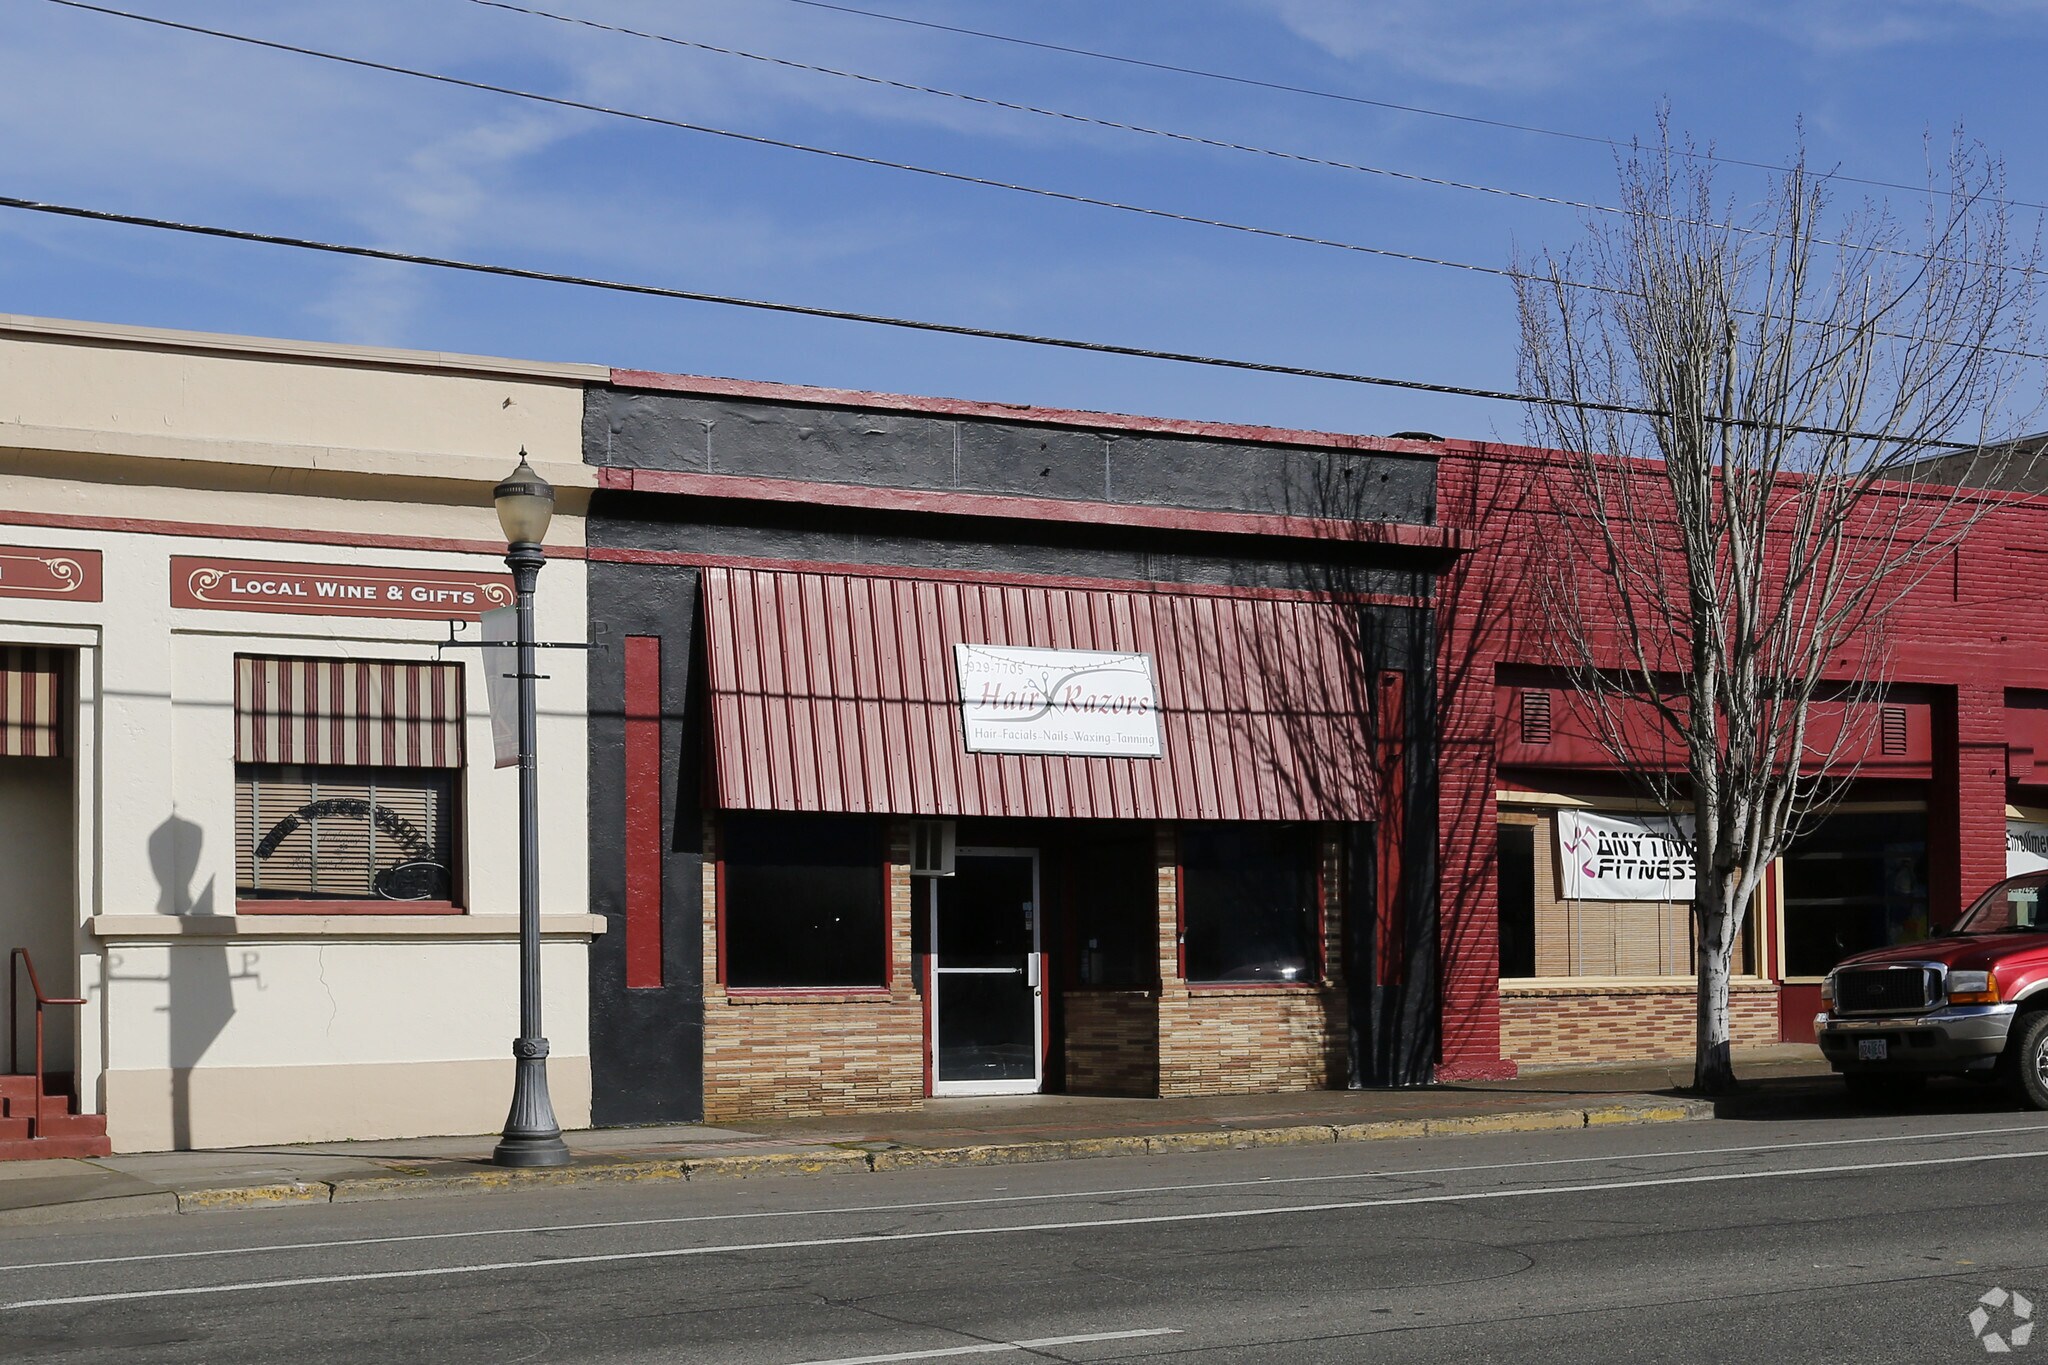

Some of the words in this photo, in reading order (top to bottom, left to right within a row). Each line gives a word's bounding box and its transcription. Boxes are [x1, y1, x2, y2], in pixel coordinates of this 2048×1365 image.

[386, 585, 404, 601] &
[968, 661, 1025, 675] 929-7705
[974, 681, 1040, 711] Hair
[1063, 684, 1150, 716] Razors
[2005, 829, 2048, 854] Enrollme
